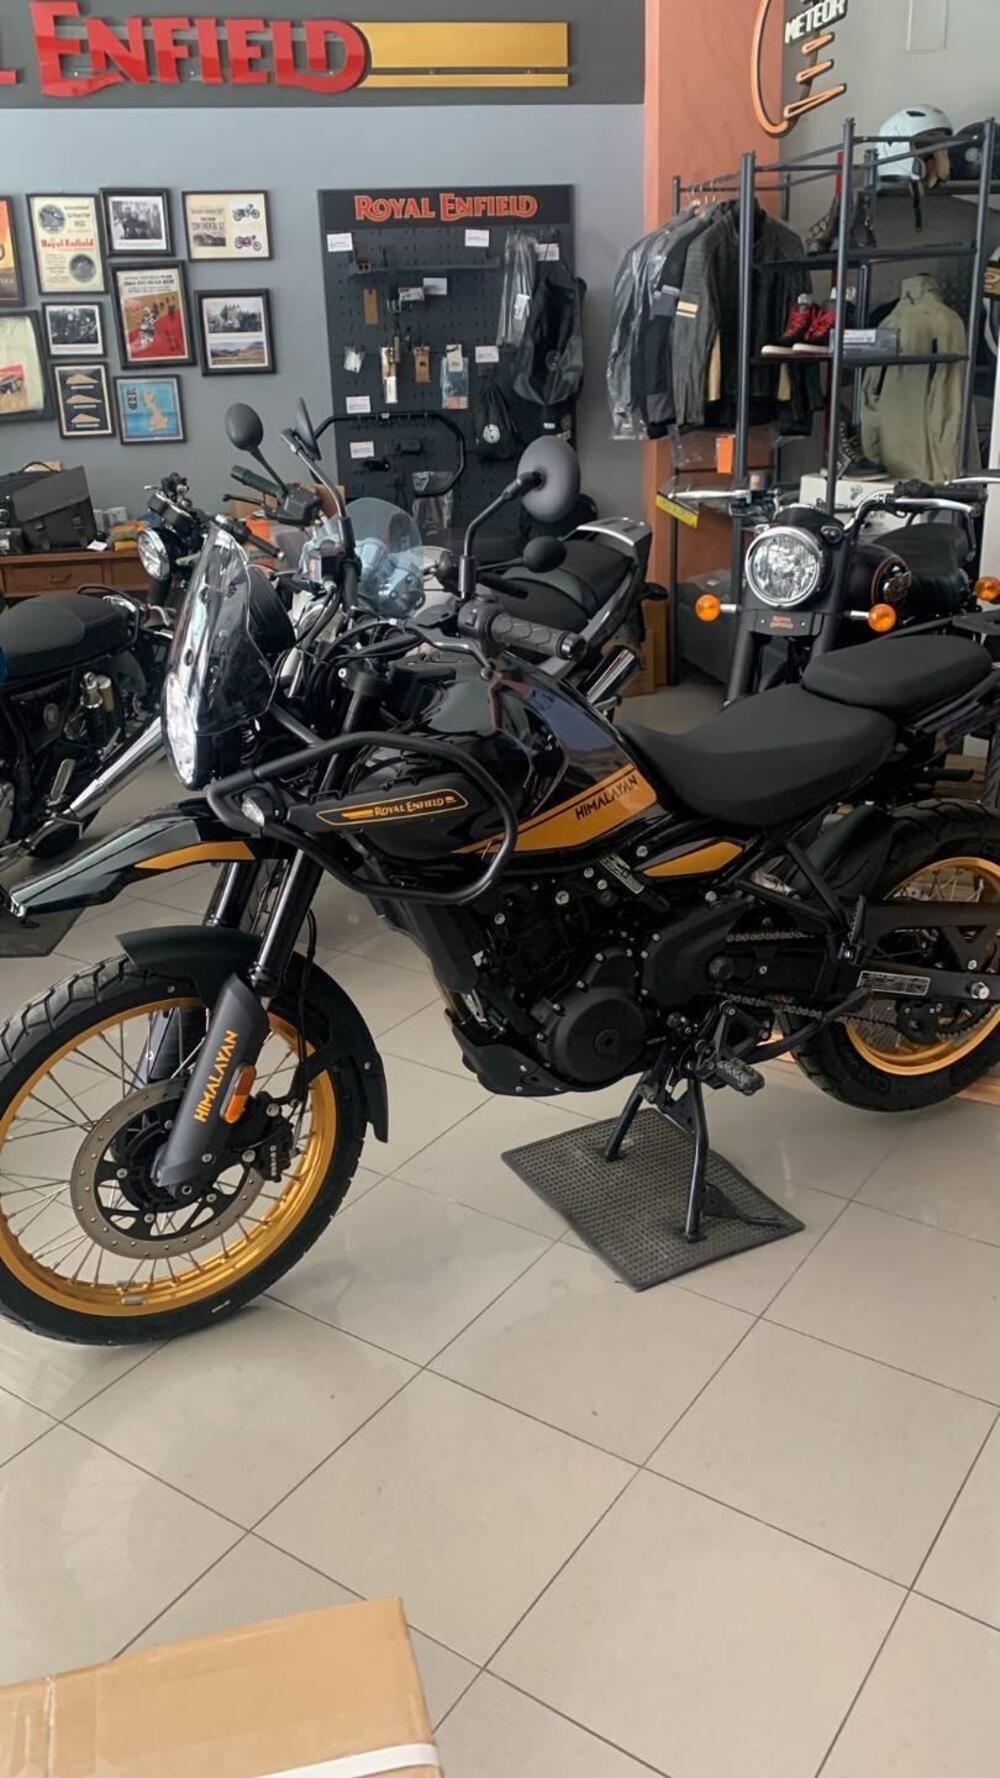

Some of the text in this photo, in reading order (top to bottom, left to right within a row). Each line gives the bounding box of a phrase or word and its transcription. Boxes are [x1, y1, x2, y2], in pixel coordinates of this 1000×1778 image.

[785, 0, 846, 44] METEOR
[30, 0, 368, 97] ENFIELD
[354, 193, 538, 222] ROYAL ENFIELD
[374, 796, 444, 817] ROYAL ENFIELD
[575, 774, 638, 820] HIMALAYAN
[193, 1029, 238, 1122] HIMALAYAN
